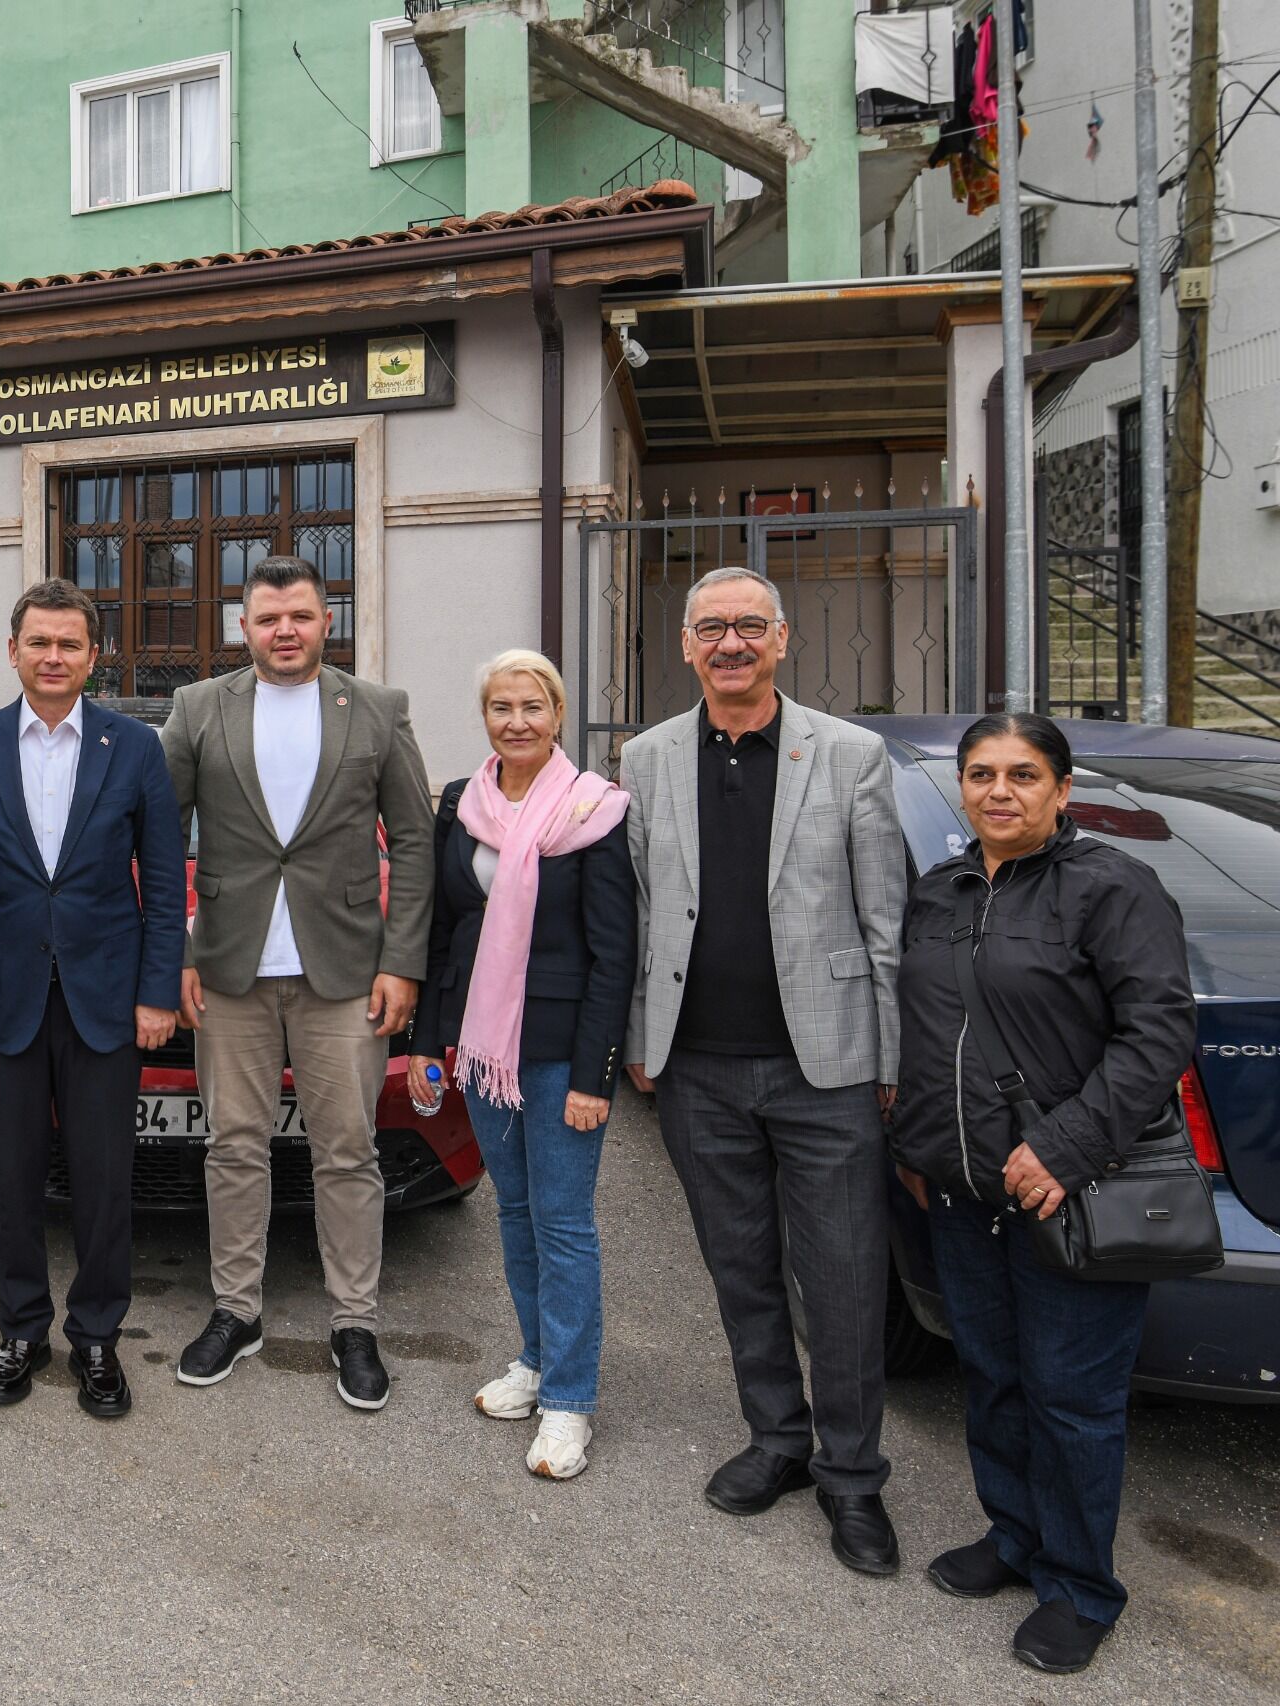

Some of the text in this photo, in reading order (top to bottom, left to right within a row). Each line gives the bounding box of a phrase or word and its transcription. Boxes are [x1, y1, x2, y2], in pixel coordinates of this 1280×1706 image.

[160, 338, 327, 382] BELEDİYESİ
[170, 377, 348, 419] MUHTARLIĞI
[1202, 1045, 1280, 1057] FOCU
